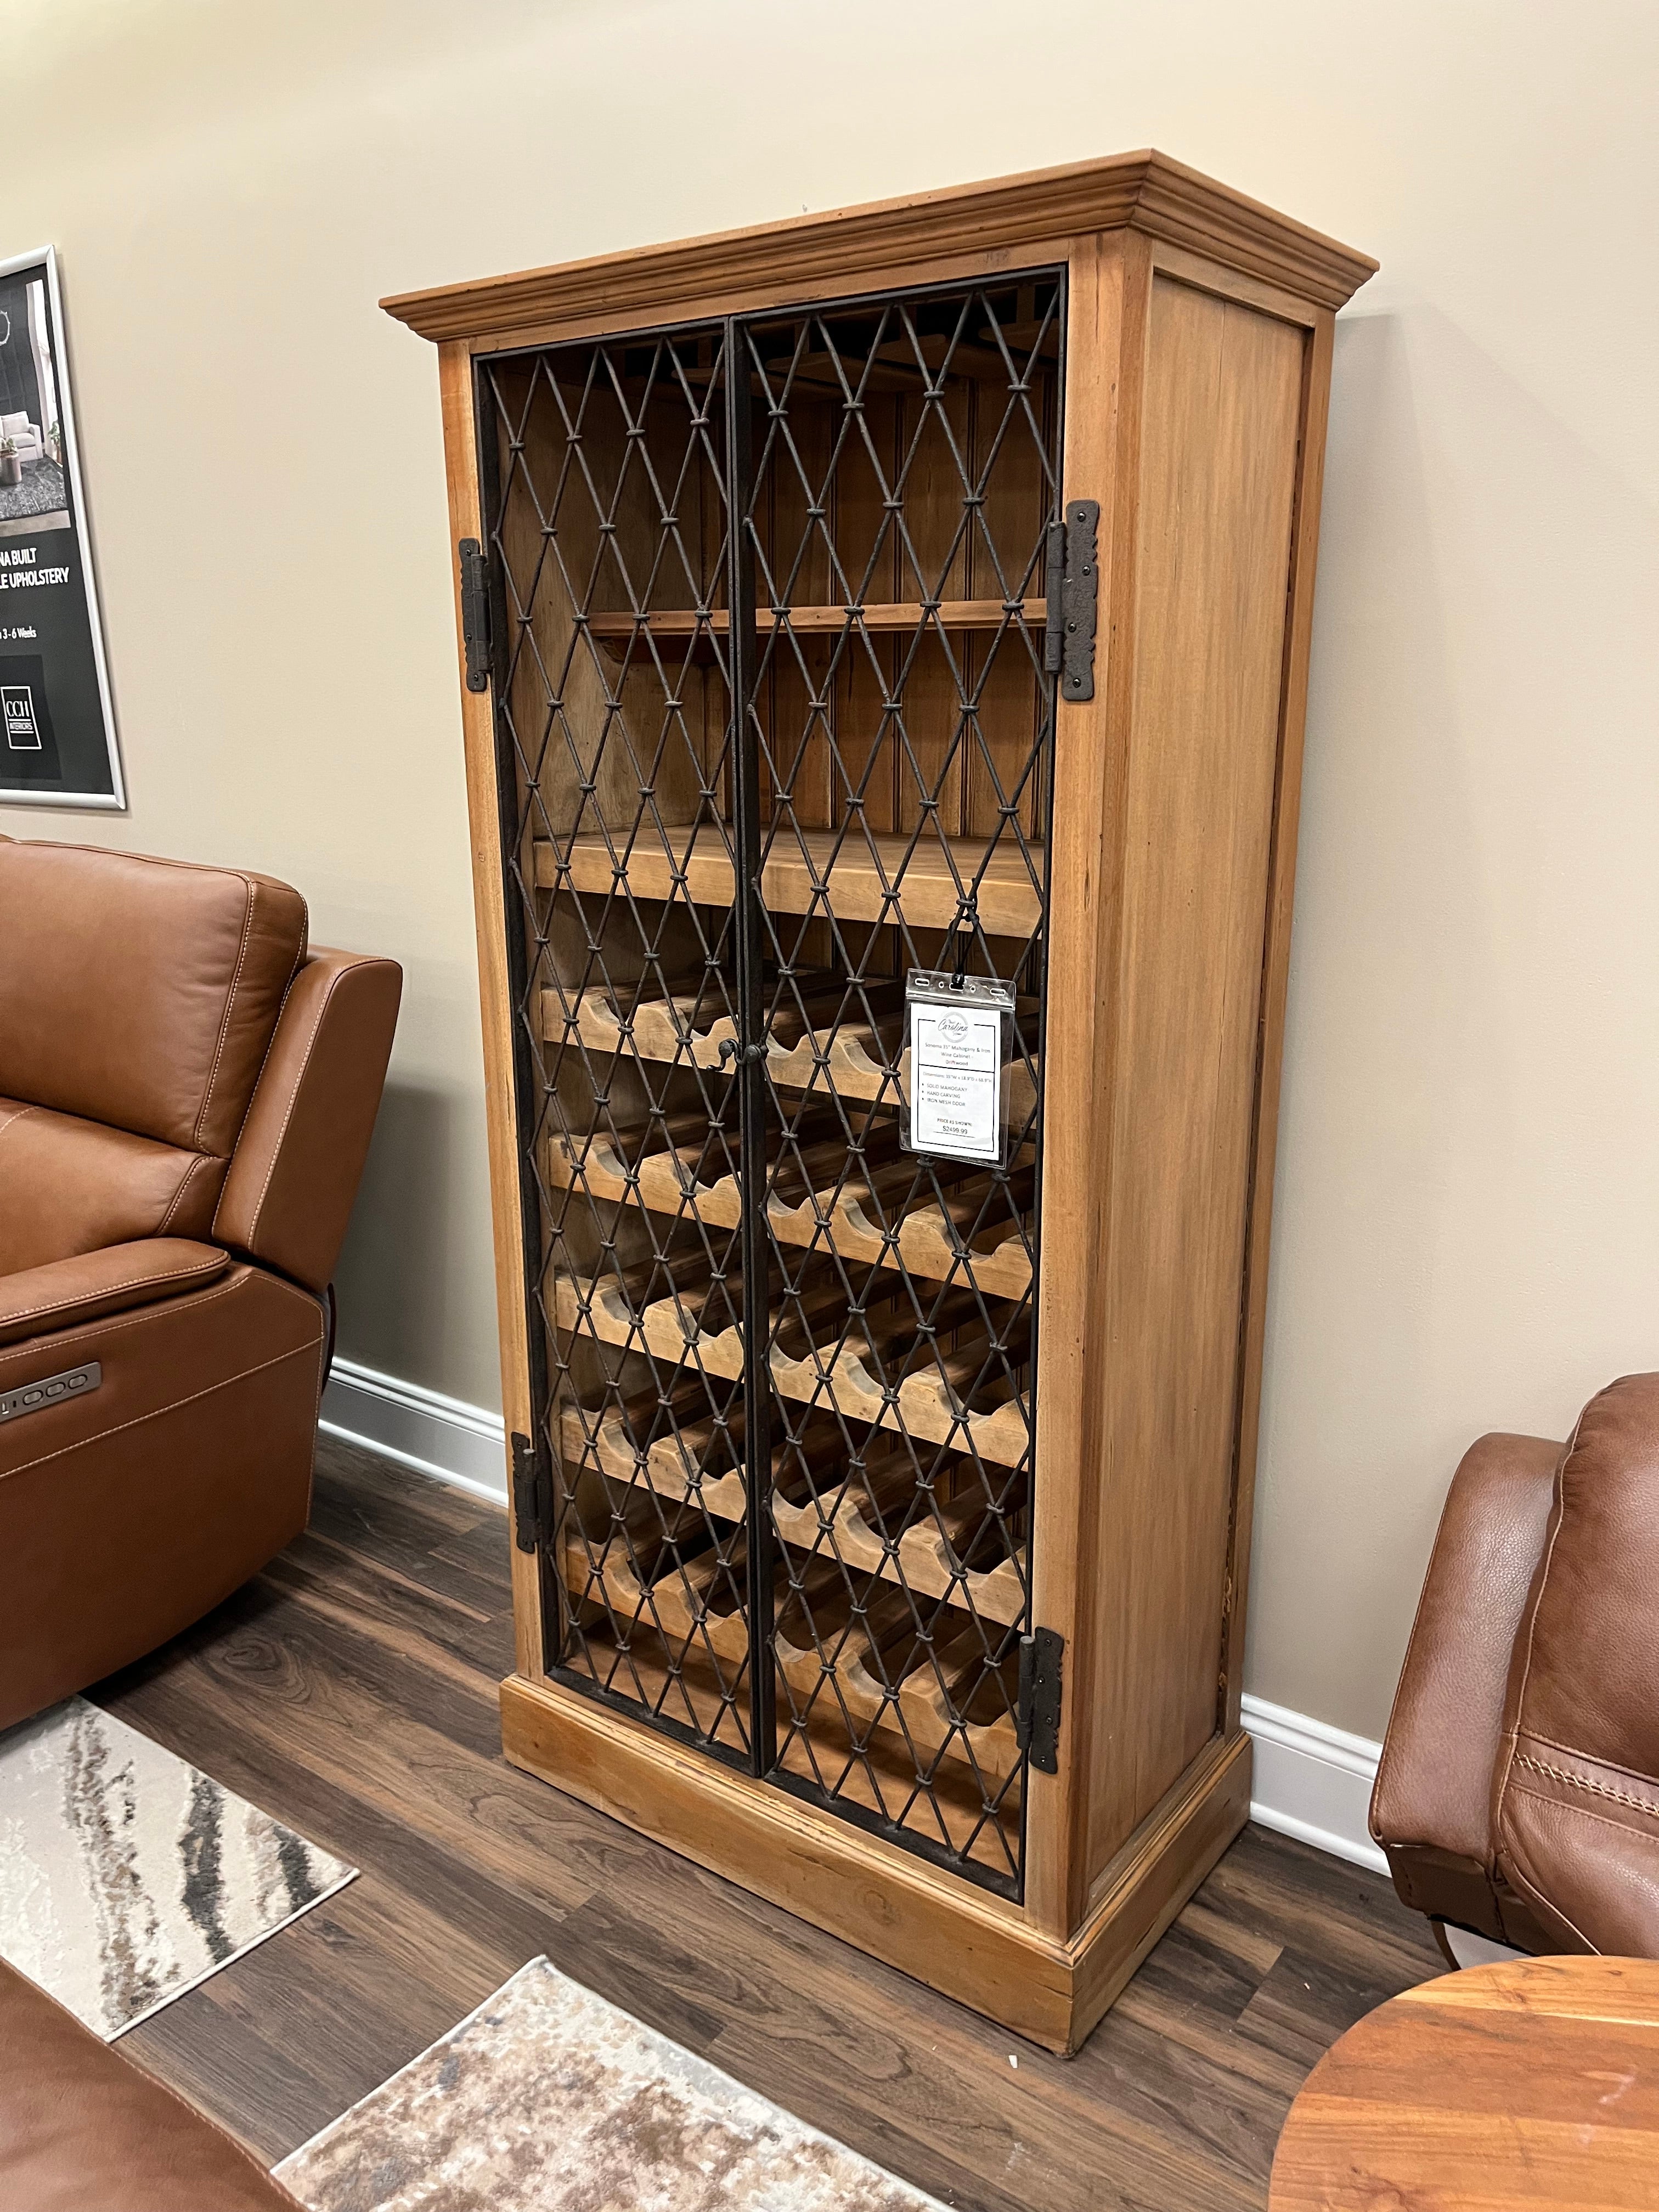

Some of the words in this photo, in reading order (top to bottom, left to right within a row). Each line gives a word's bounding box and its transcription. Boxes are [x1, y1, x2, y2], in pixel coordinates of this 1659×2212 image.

[11, 548, 37, 566] BUILT
[0, 573, 9, 589] E
[9, 567, 69, 588] UPHOLSTERY
[938, 1018, 968, 1031] Carolina
[942, 1125, 968, 1135] $2499.99
